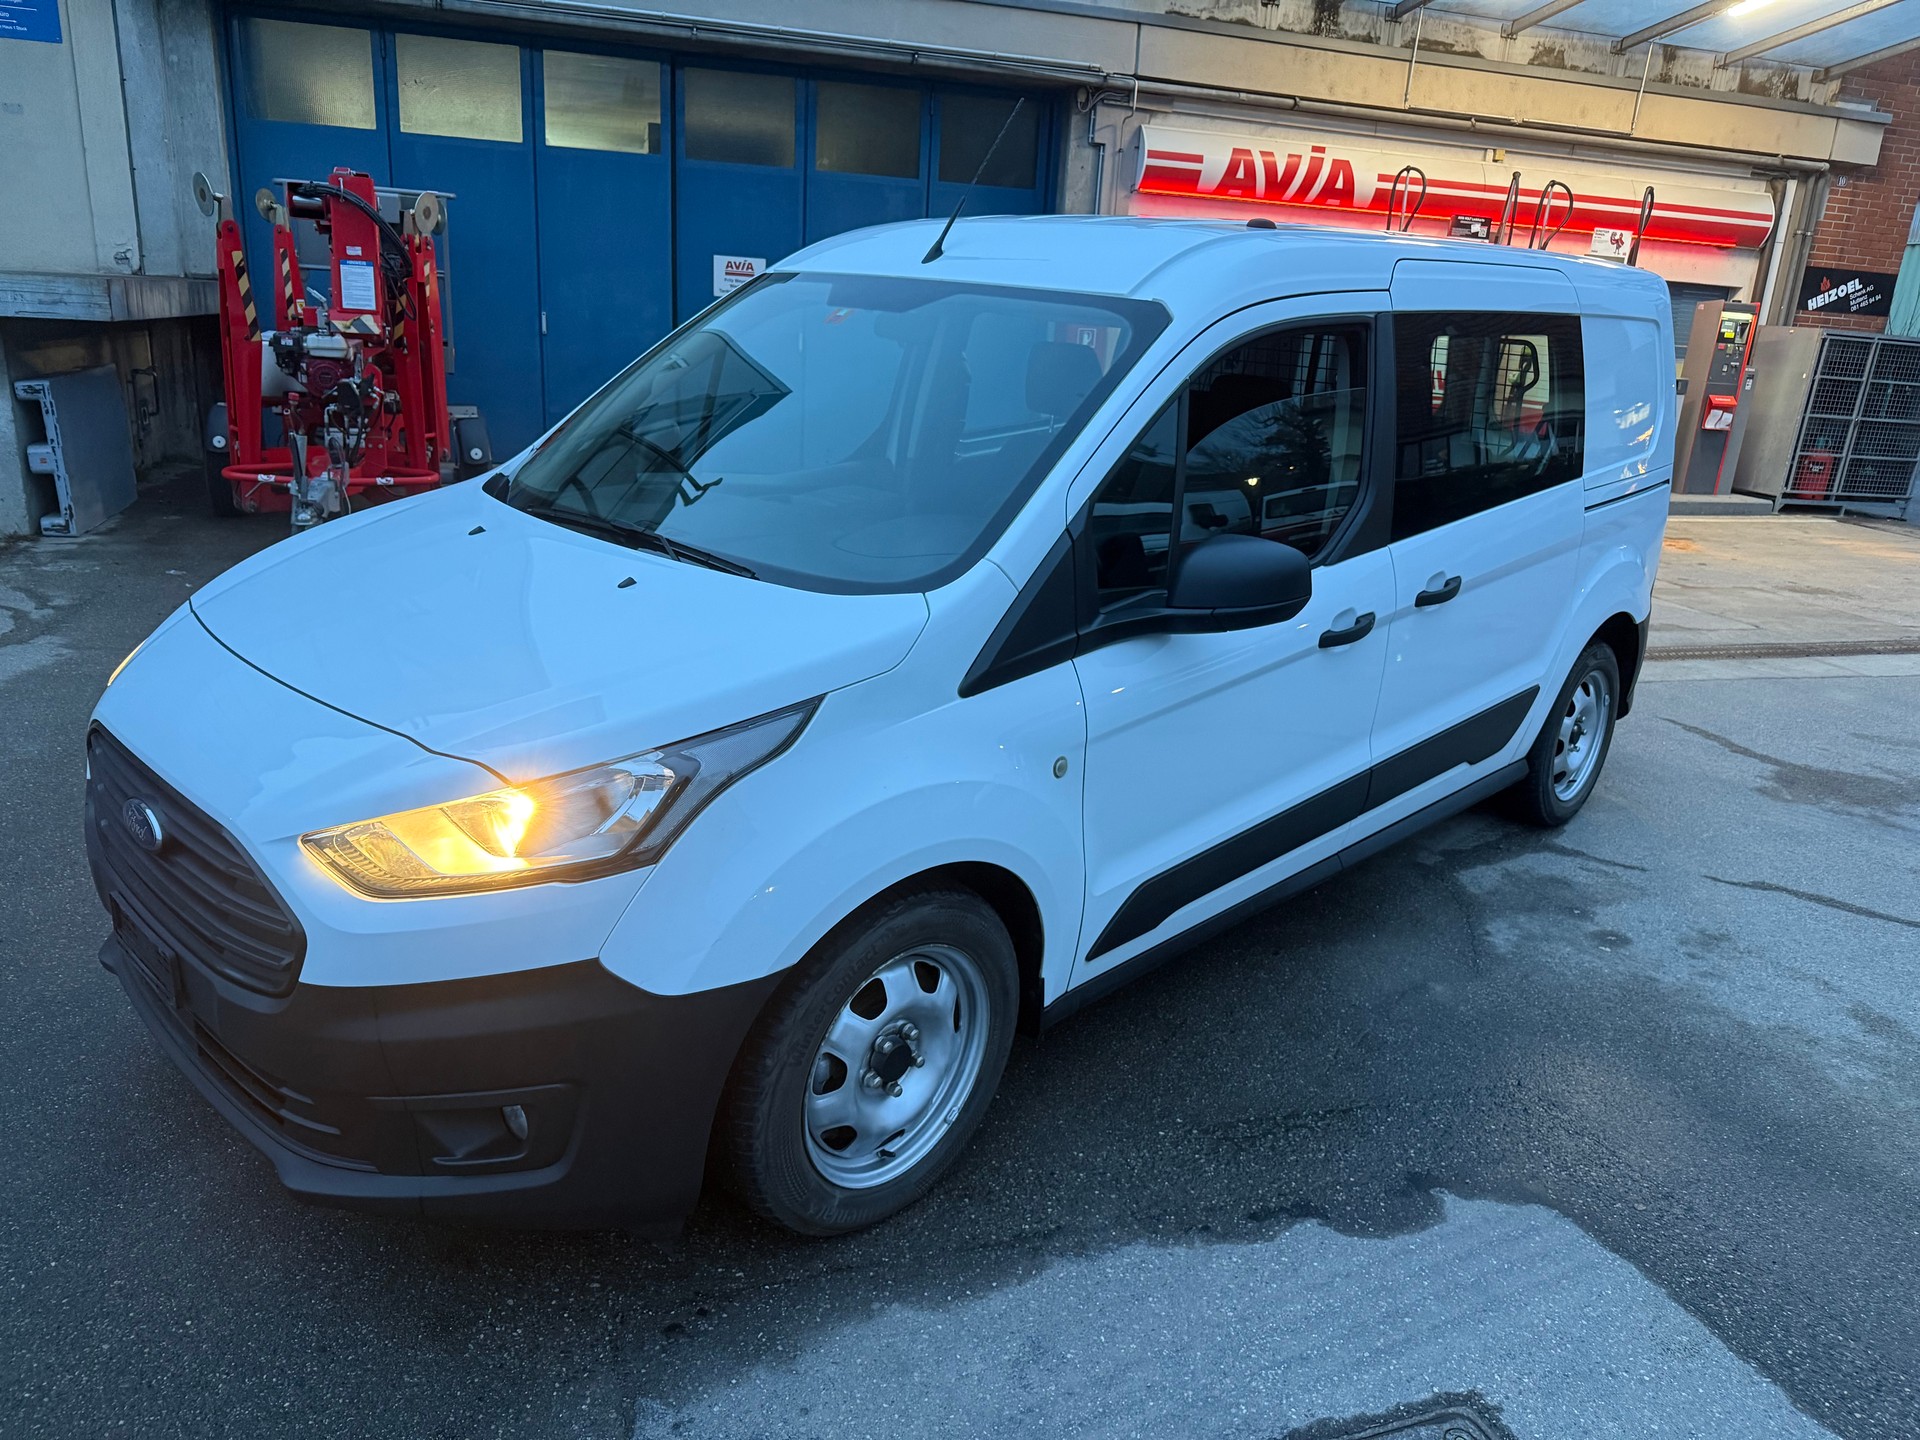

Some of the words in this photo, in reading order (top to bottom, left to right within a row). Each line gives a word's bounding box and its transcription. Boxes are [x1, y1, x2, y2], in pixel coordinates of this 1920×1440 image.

[1213, 145, 1355, 208] AVIA
[725, 259, 754, 271] AVIA
[1807, 278, 1862, 310] HEIZOEL
[1849, 288, 1866, 300] Schenk
[1866, 284, 1874, 292] AG
